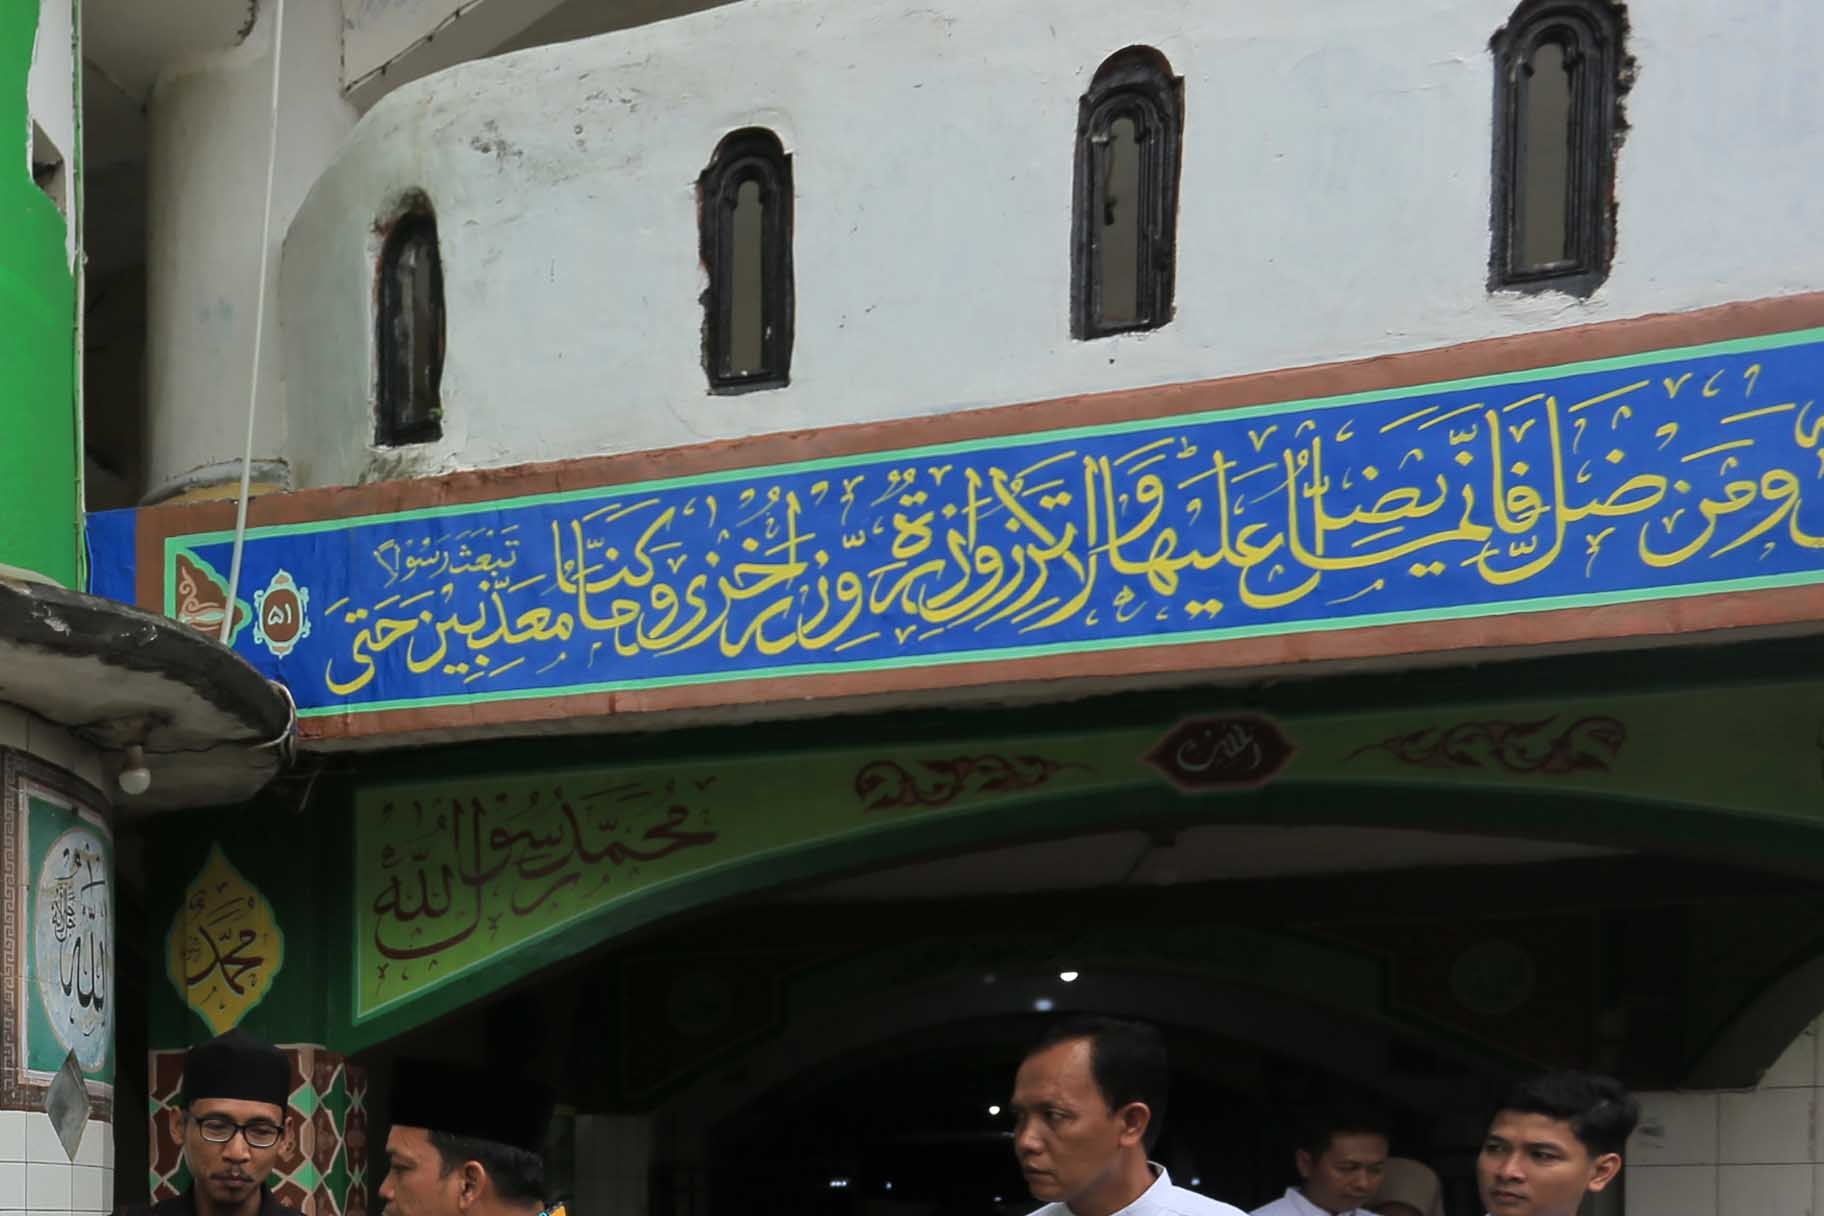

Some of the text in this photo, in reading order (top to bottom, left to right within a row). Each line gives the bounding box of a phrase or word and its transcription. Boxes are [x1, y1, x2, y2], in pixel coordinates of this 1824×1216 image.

[1100, 449, 1285, 618] عليها
[1240, 436, 1448, 610] يضل
[1478, 396, 1668, 585] ضل
[1639, 468, 1800, 568] ومن
[325, 606, 419, 695] حتى
[407, 578, 574, 676] معذبين
[186, 925, 265, 996] محمد
